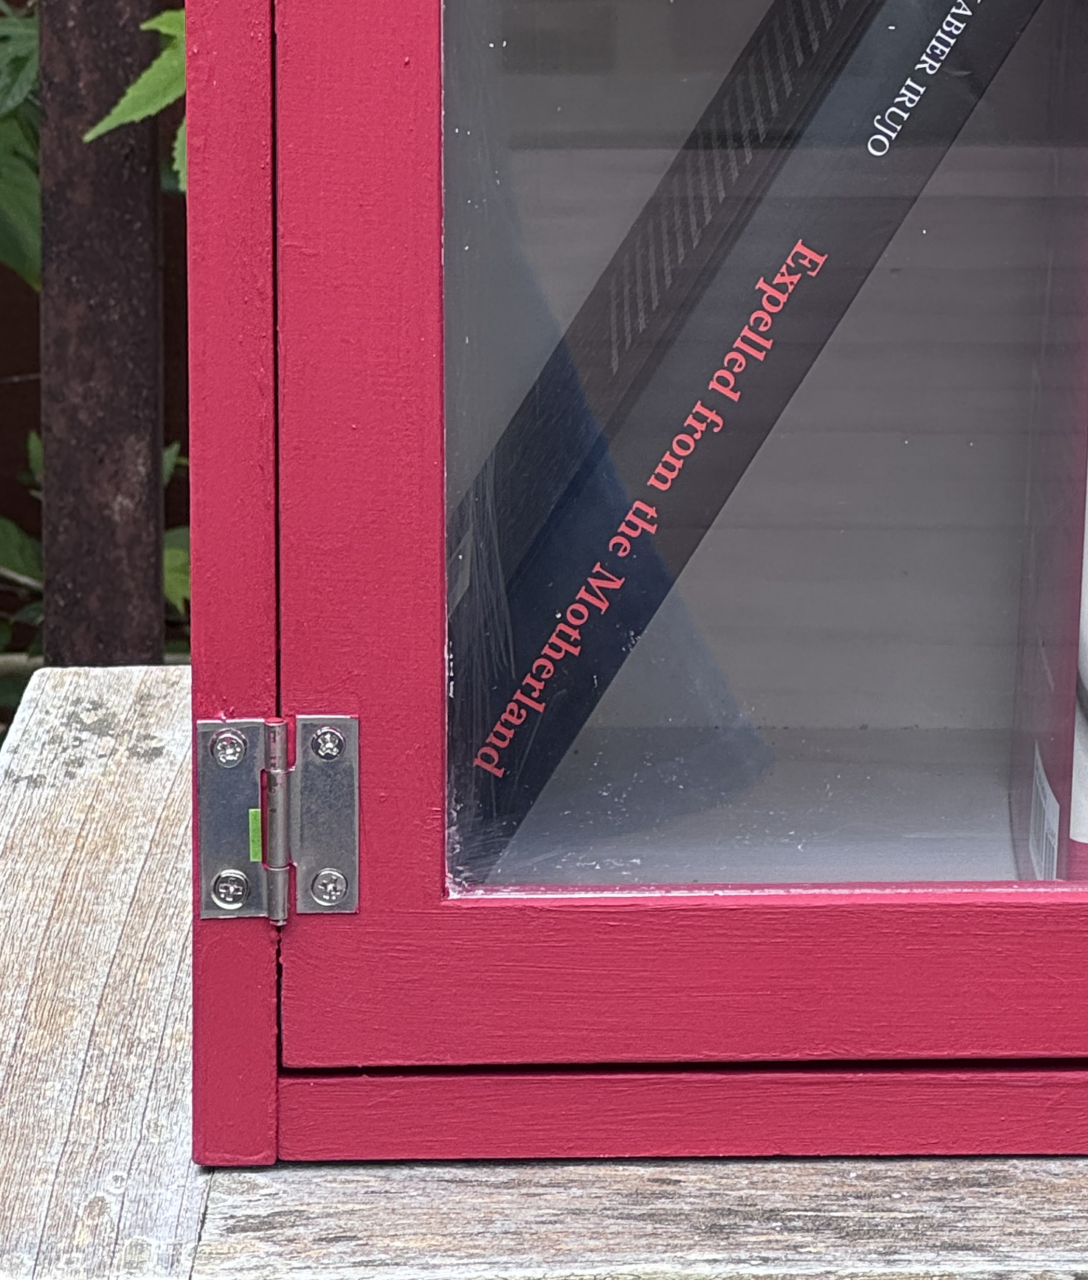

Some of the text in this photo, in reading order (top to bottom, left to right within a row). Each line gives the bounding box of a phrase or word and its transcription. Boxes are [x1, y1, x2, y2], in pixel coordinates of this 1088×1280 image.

[867, 76, 926, 157] IRUJO
[473, 239, 828, 778] Expelled from the Motherland
